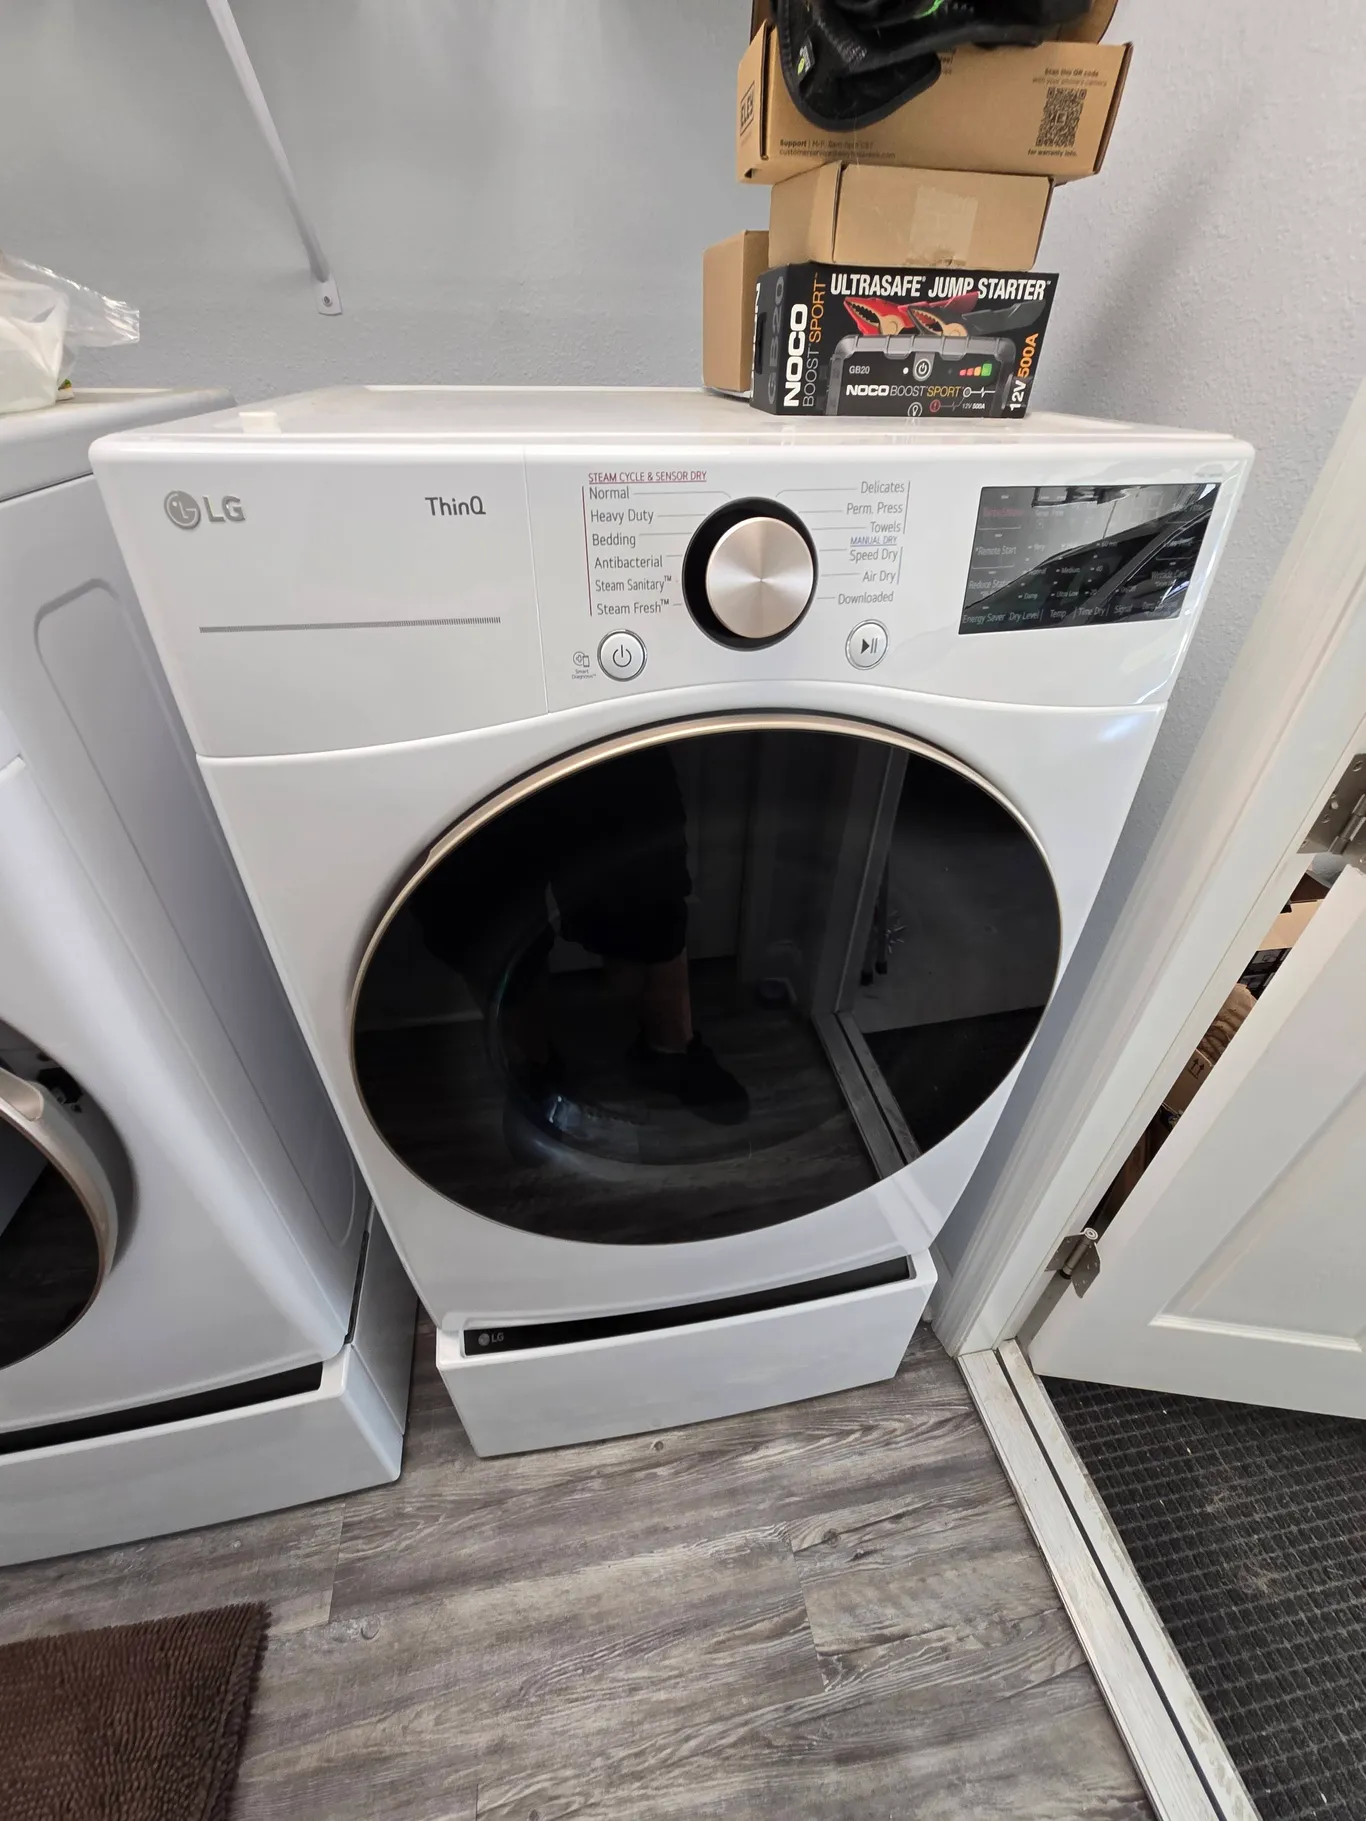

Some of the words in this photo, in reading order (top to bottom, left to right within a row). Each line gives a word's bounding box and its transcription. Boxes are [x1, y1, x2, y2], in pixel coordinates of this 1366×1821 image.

[780, 139, 807, 149] Support
[928, 276, 974, 299] JUMP
[977, 277, 1047, 301] STARTER
[783, 303, 808, 407] NOCO
[849, 365, 871, 375] GB20
[1006, 379, 1027, 411] 12V
[1017, 332, 1039, 379] 500A
[846, 384, 890, 397] NOCO
[588, 472, 617, 483] STEAM
[619, 471, 645, 482] CYCLE
[647, 472, 654, 481] &
[655, 470, 688, 481] SENSOR
[690, 470, 707, 480] DRY
[589, 485, 630, 500] Normal
[860, 480, 905, 494] Delicates
[202, 496, 246, 523] LG
[425, 495, 487, 516] ThinQ
[846, 502, 874, 515] Perm.
[877, 501, 904, 514] Press
[590, 508, 625, 525] Heavy
[628, 508, 654, 524] Duty
[870, 520, 901, 533] Towels
[592, 532, 636, 548] Bedding
[850, 536, 880, 545] MANUAL
[882, 535, 898, 545] DRY
[594, 554, 663, 569] Antibacterial
[849, 547, 880, 564] Speed
[881, 547, 899, 562] Dry
[862, 570, 877, 583] Air
[879, 569, 896, 584] Dry
[595, 579, 625, 592] Steam
[838, 591, 895, 605] Downloaded
[596, 602, 631, 616] Steam
[1093, 606, 1106, 617] Dry
[962, 614, 986, 625] Energy
[986, 612, 1006, 622] Saver
[1008, 611, 1021, 622] Dry
[1022, 610, 1039, 621] Level
[491, 1332, 505, 1343] LG
